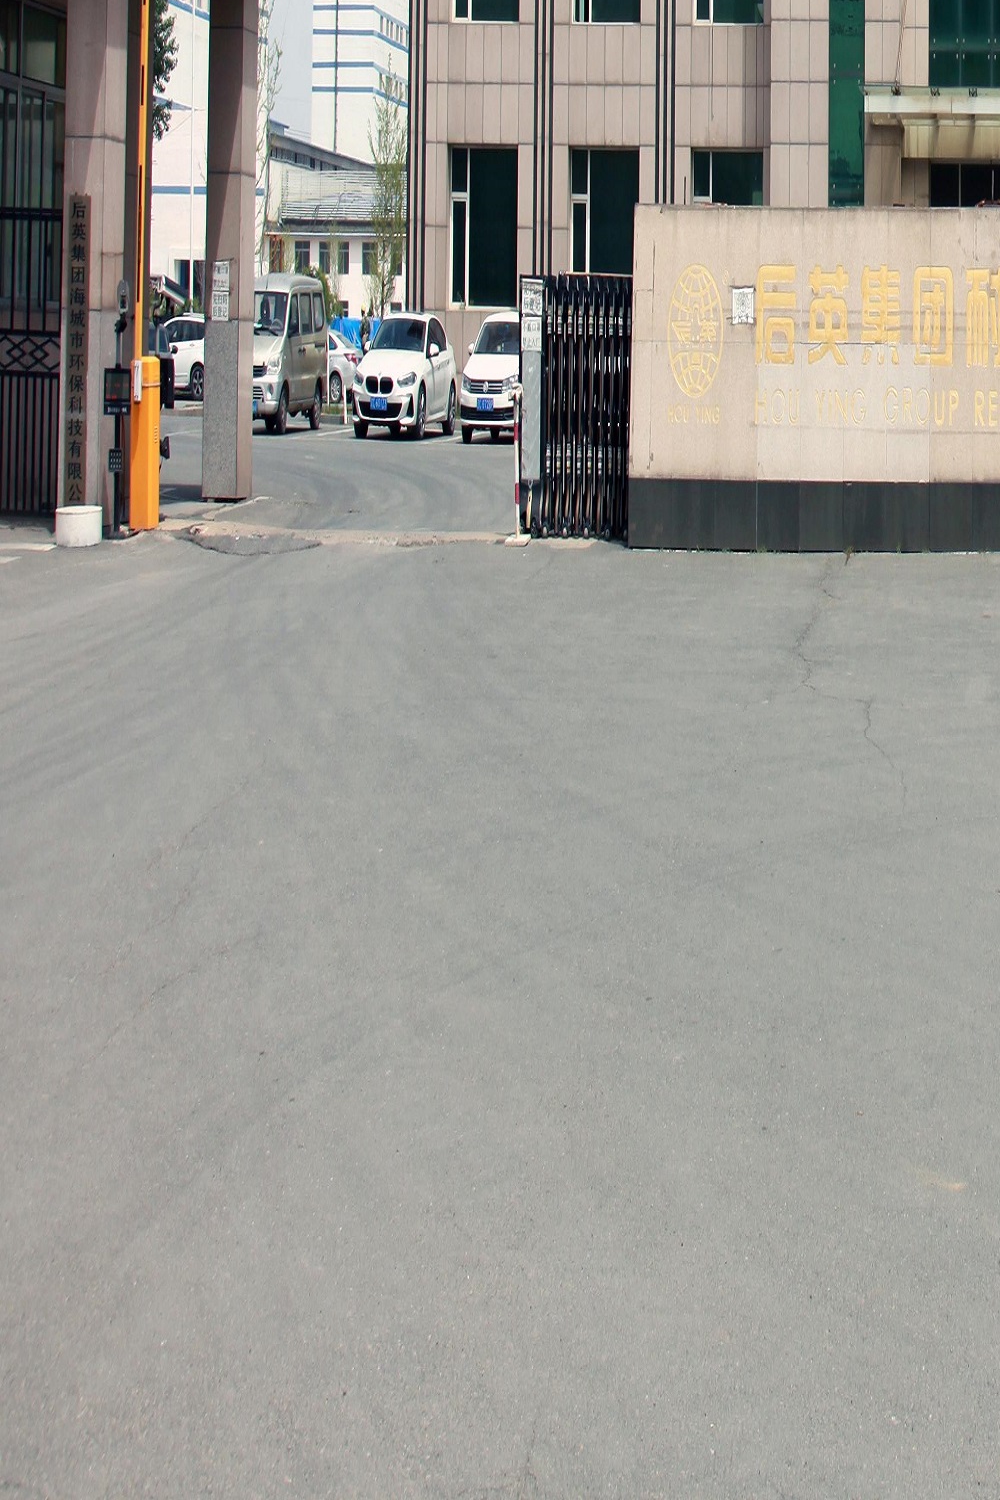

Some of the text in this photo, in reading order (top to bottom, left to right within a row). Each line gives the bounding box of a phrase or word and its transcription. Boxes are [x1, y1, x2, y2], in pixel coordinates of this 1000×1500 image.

[668, 403, 720, 424] HOU YING
[754, 387, 800, 425] HOU
[814, 387, 866, 425] YING
[883, 385, 960, 427] GROUP
